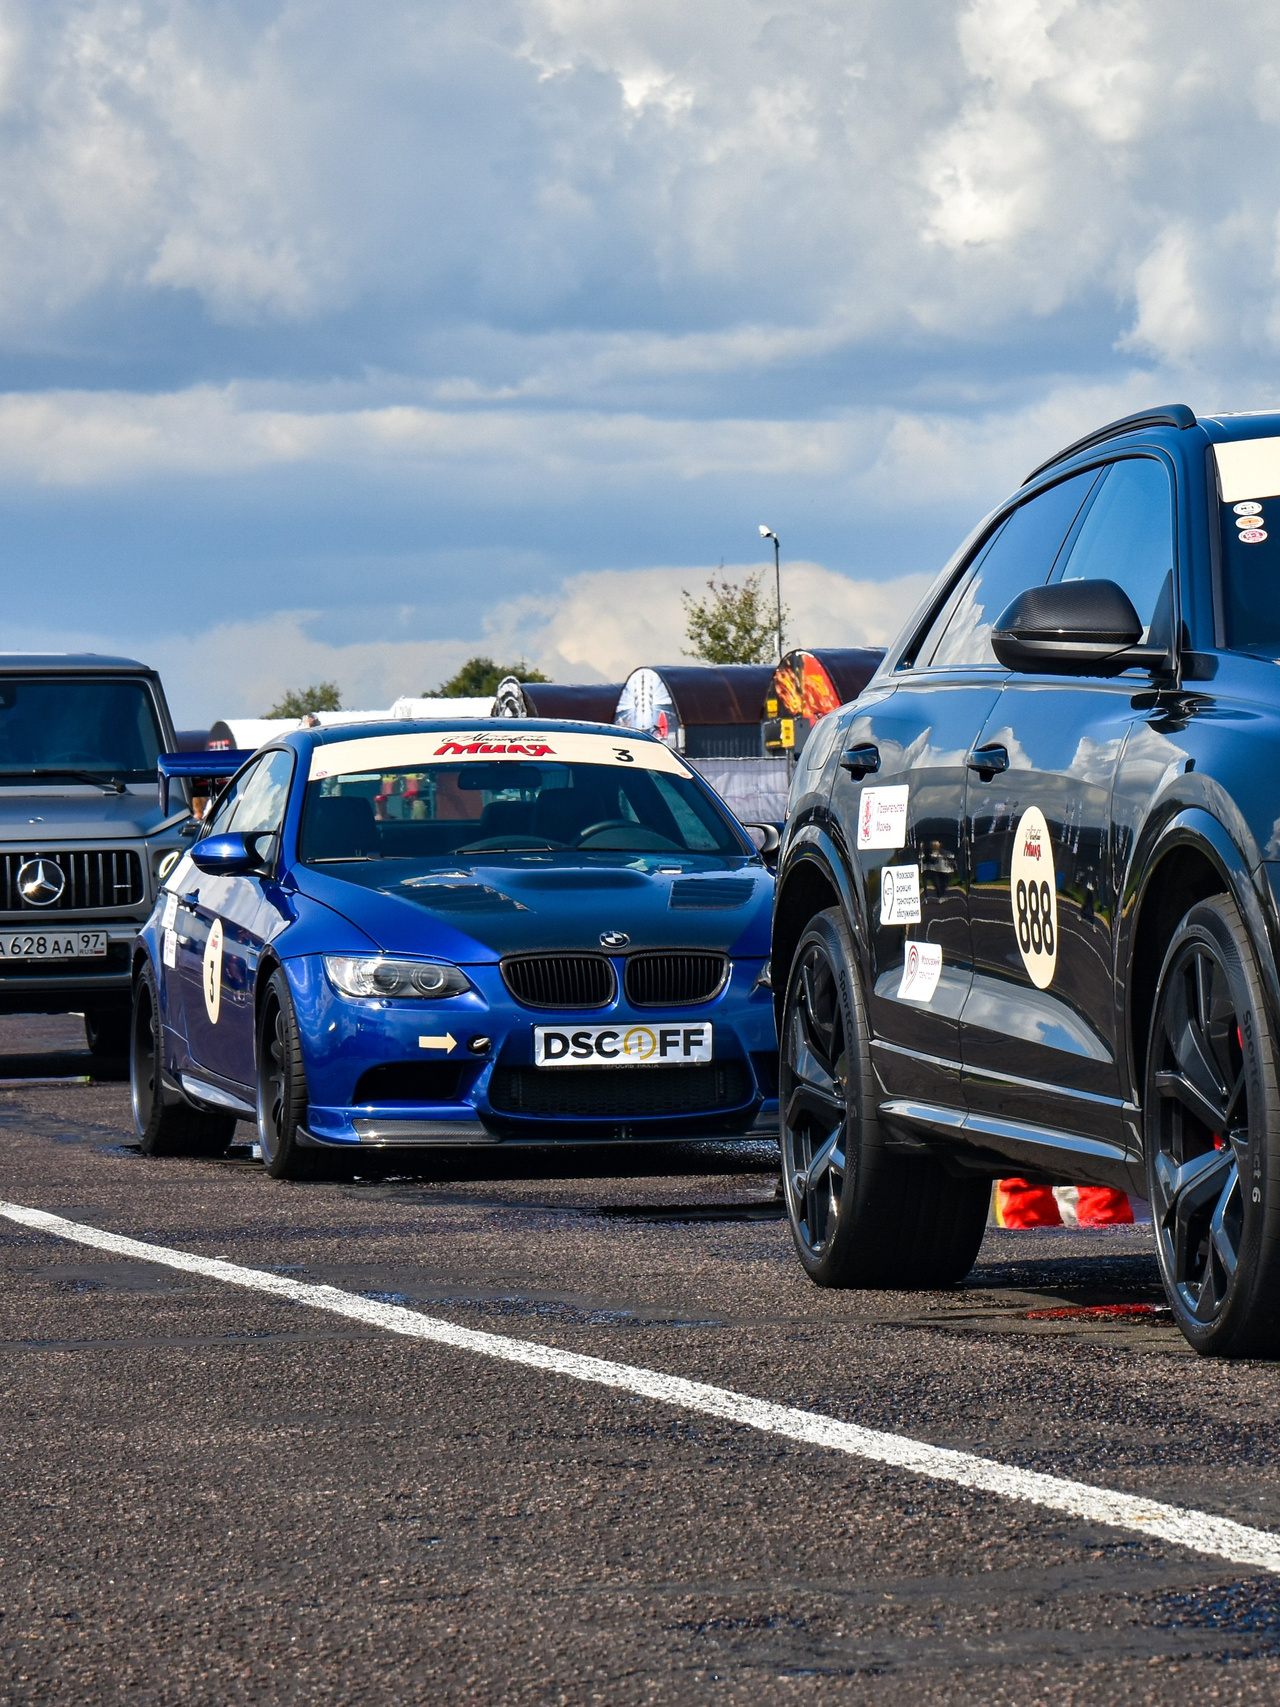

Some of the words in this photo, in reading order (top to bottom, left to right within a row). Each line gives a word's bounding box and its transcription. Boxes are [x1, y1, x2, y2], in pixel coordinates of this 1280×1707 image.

[432, 742, 558, 757] Миля
[612, 747, 635, 763] 3
[1016, 878, 1055, 956] 888
[81, 934, 100, 949] 97
[1251, 1185, 1262, 1204] 6
